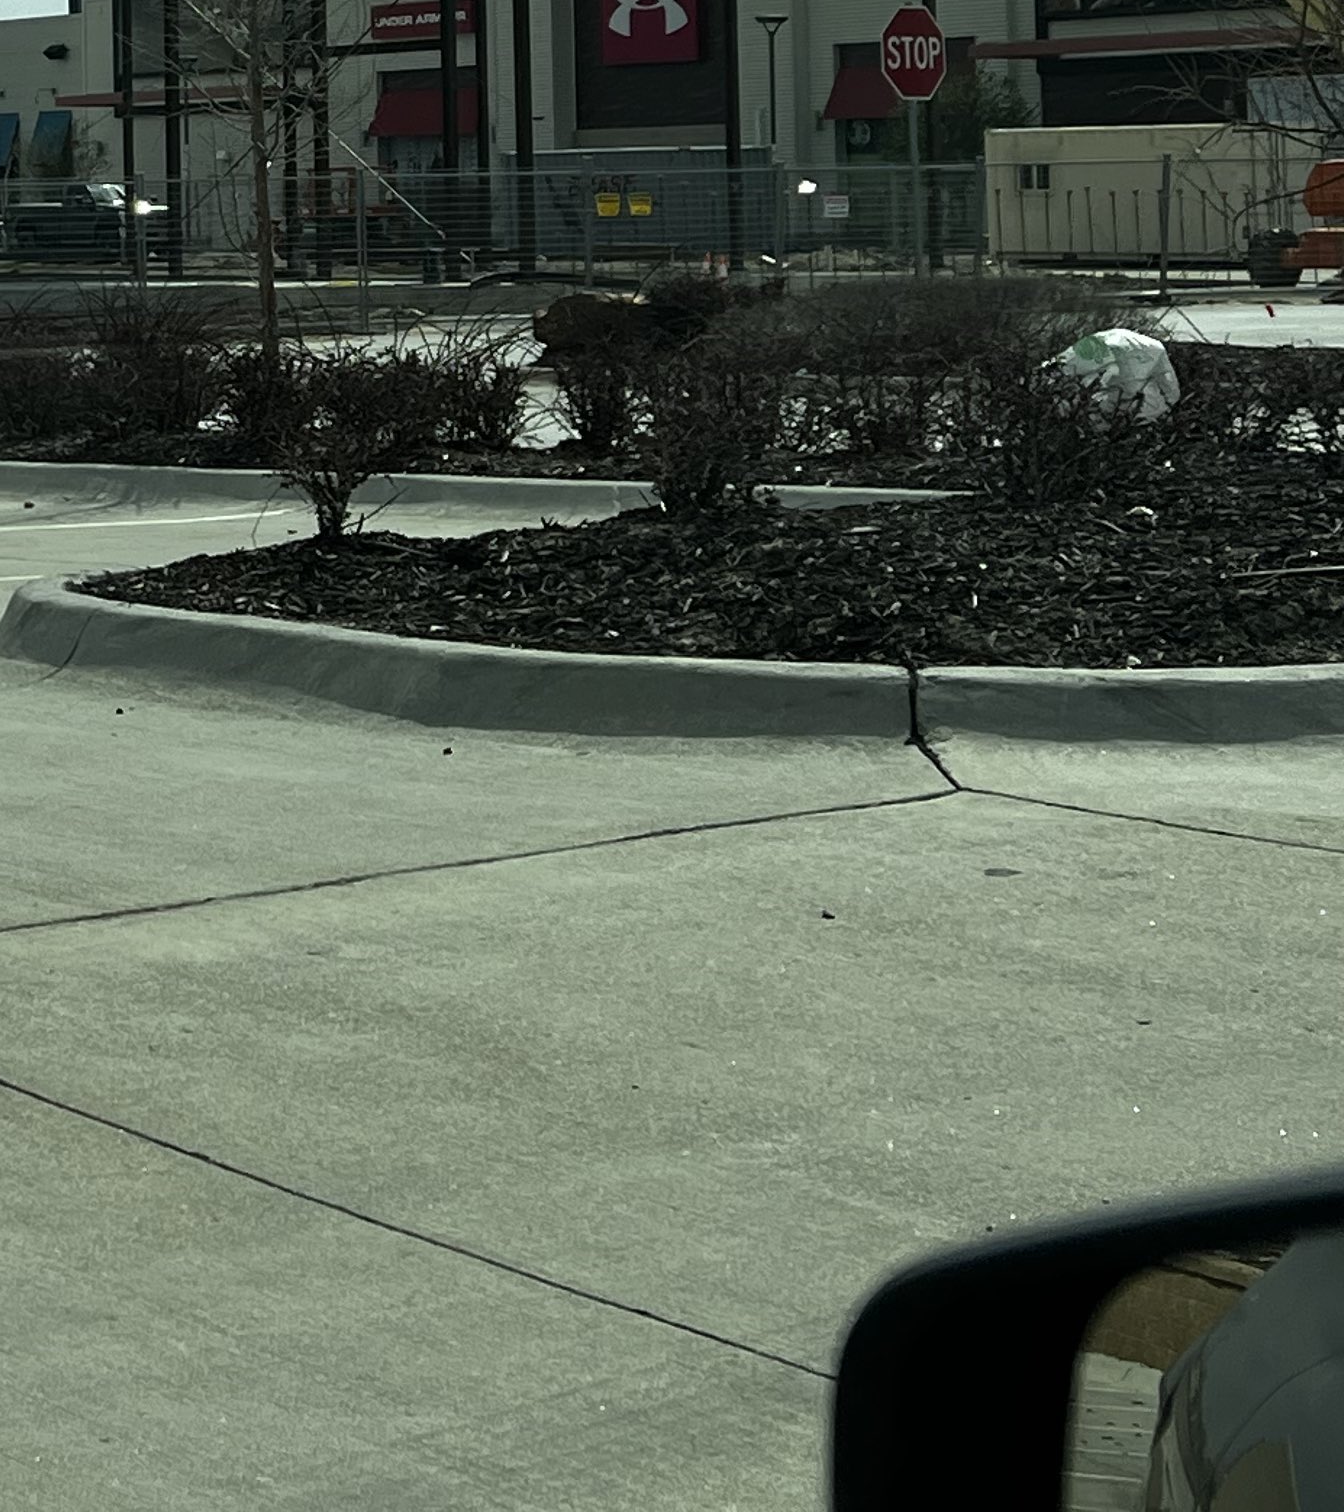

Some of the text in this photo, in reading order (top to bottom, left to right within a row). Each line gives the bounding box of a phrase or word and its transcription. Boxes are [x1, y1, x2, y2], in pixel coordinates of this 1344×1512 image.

[374, 10, 466, 28] UNDER ARMR
[887, 35, 941, 70] STOP
